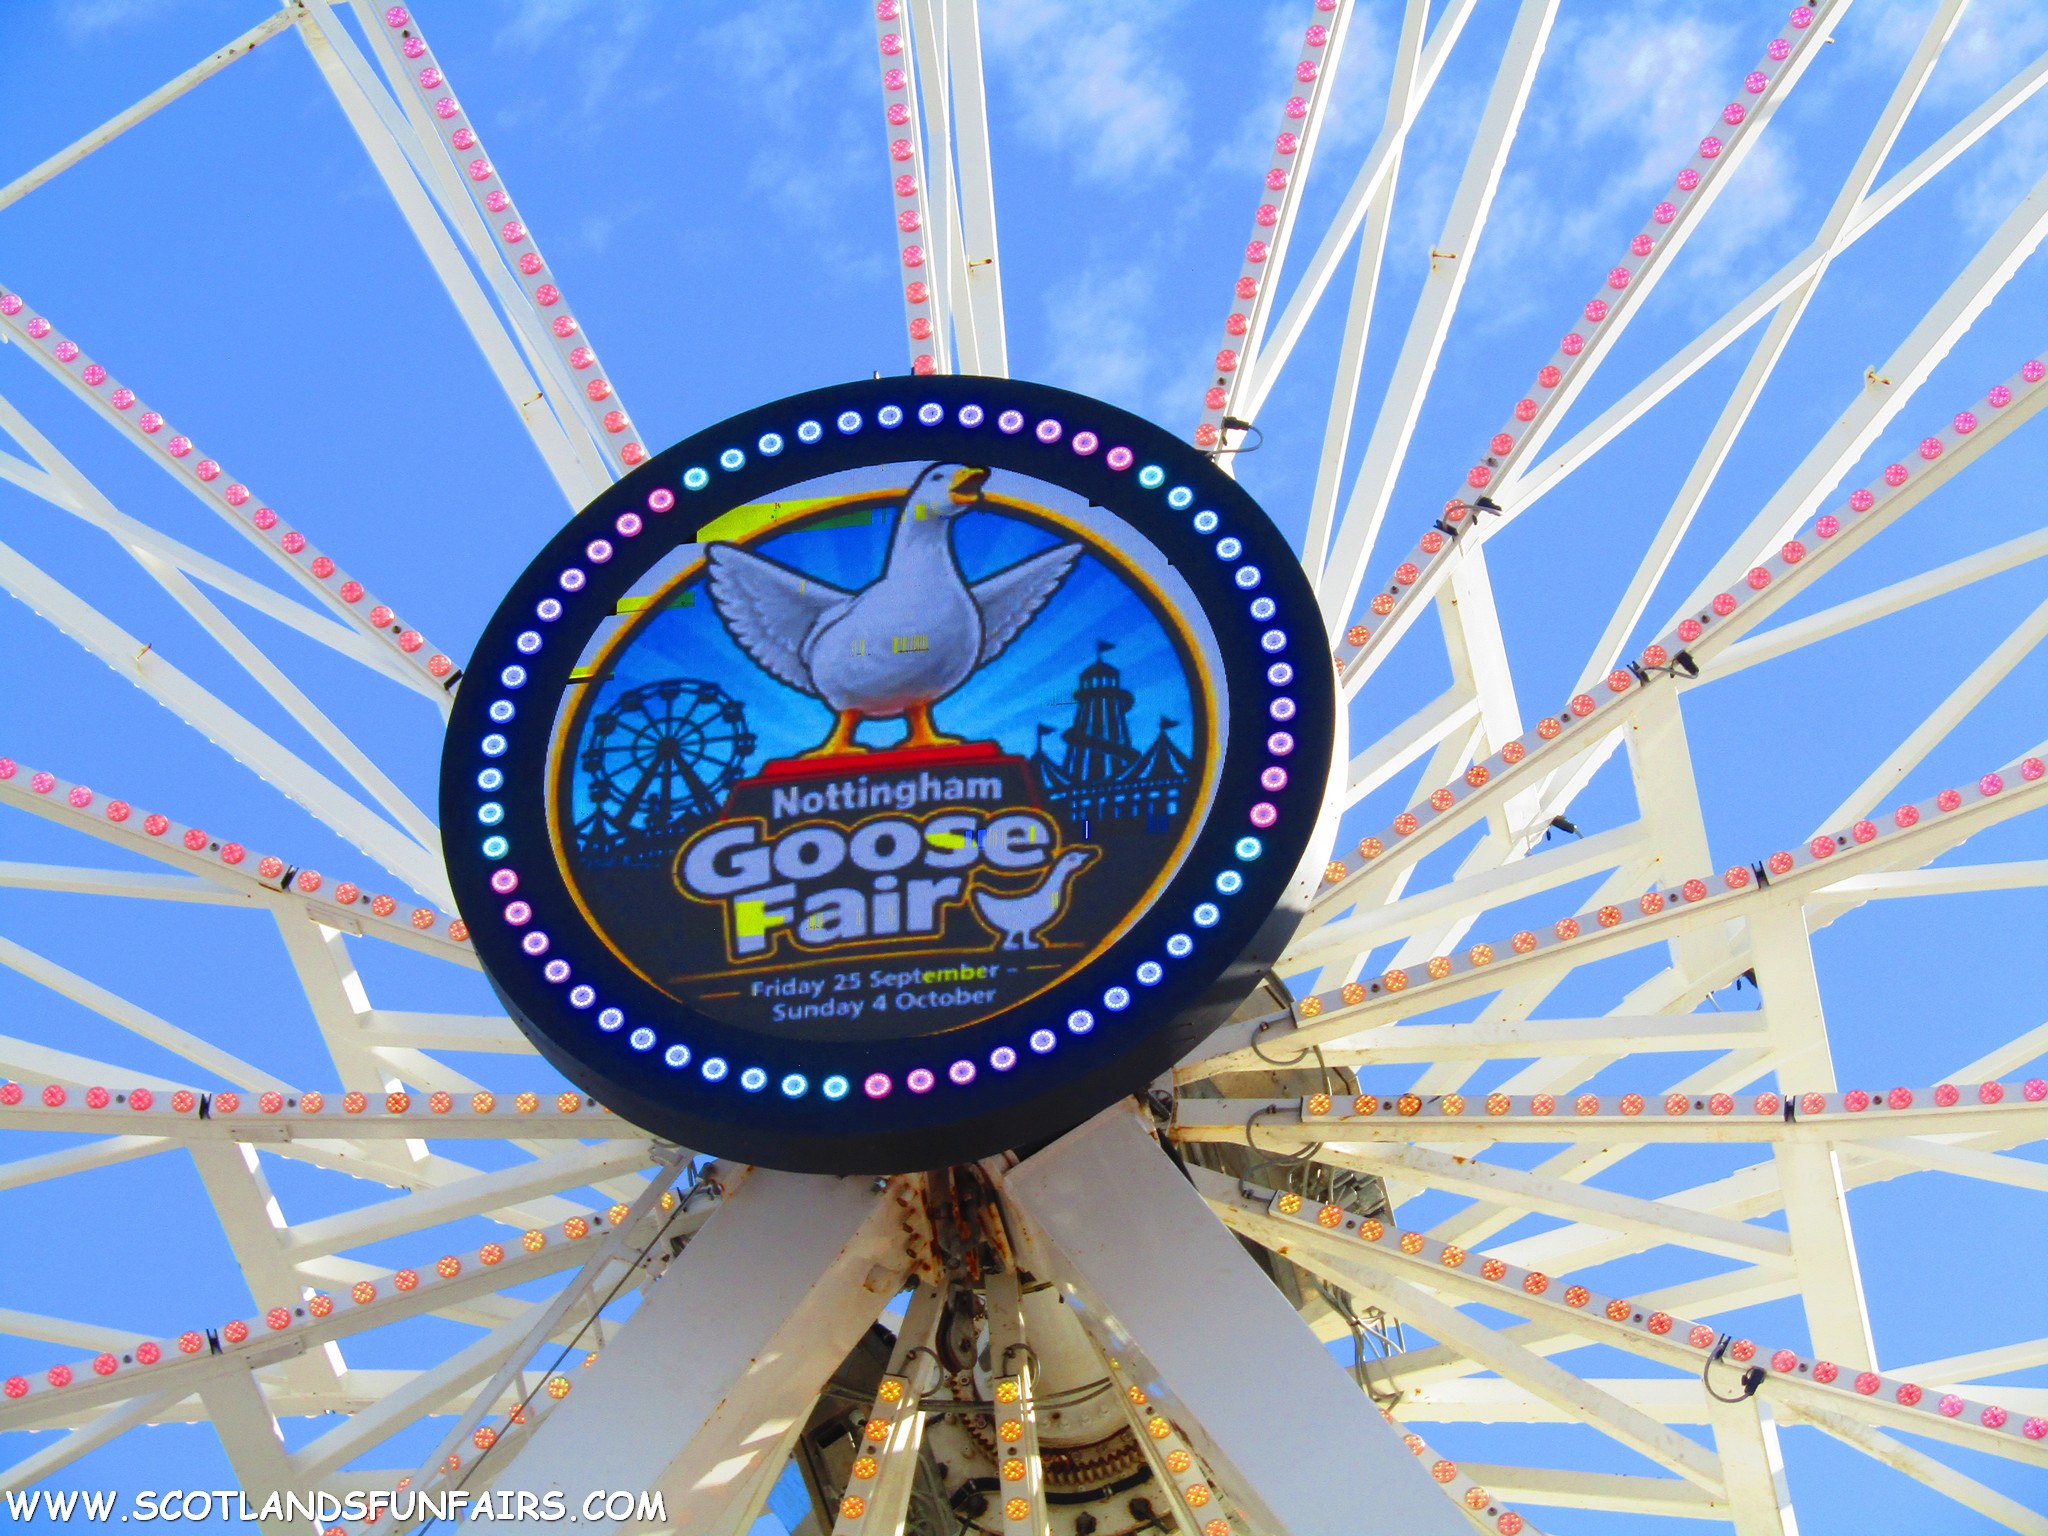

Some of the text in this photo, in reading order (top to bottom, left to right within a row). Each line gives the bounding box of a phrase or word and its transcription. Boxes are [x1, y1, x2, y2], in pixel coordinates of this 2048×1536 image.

[772, 771, 1003, 819] Nottingham
[683, 813, 1051, 896] Goose
[734, 874, 964, 954] Fair
[750, 977, 825, 999] Friday
[833, 972, 862, 991] 25
[869, 962, 1001, 988] September
[771, 987, 998, 1022] Sunday 4 October
